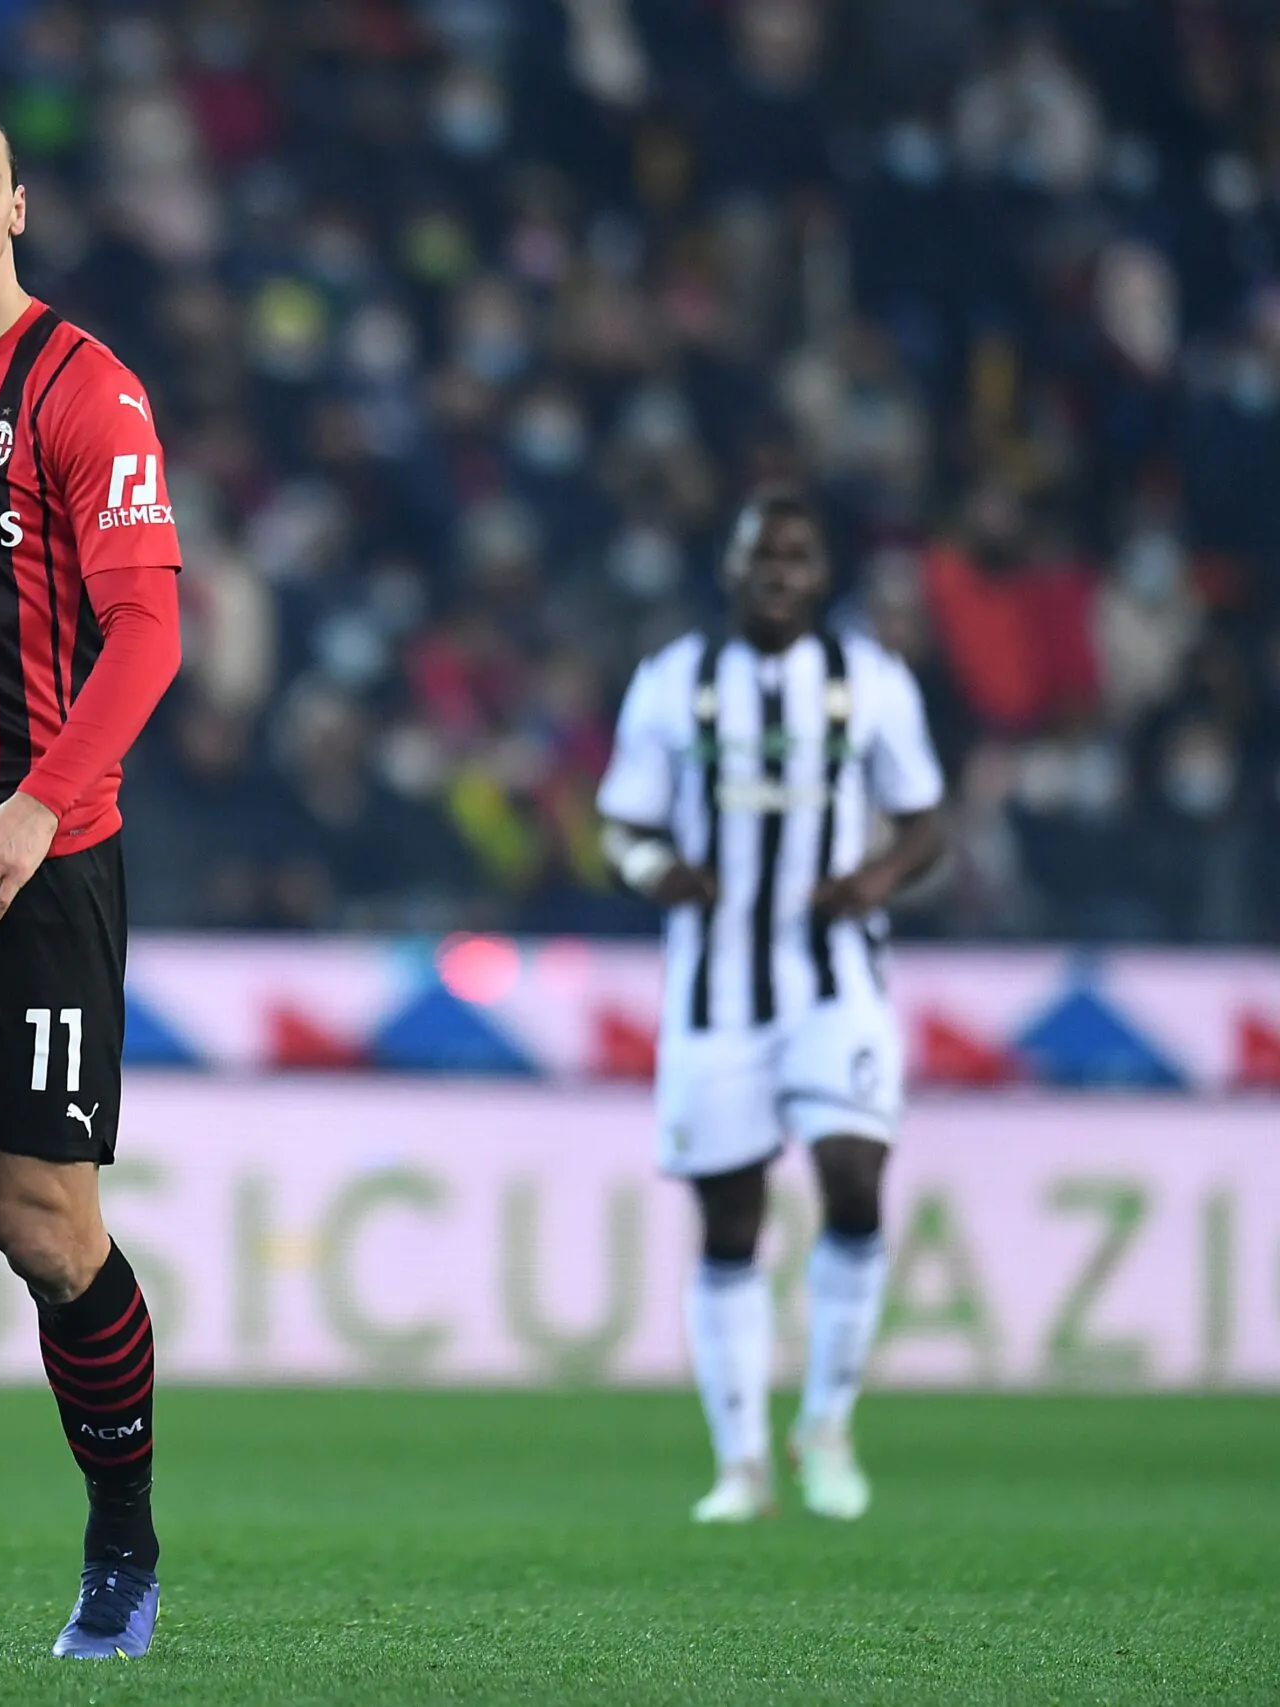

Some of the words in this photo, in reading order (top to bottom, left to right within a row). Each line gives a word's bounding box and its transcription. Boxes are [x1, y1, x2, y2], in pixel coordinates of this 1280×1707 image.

[98, 505, 175, 530] BitMEX
[26, 1008, 82, 1091] 11
[81, 1417, 143, 1439] ACM
